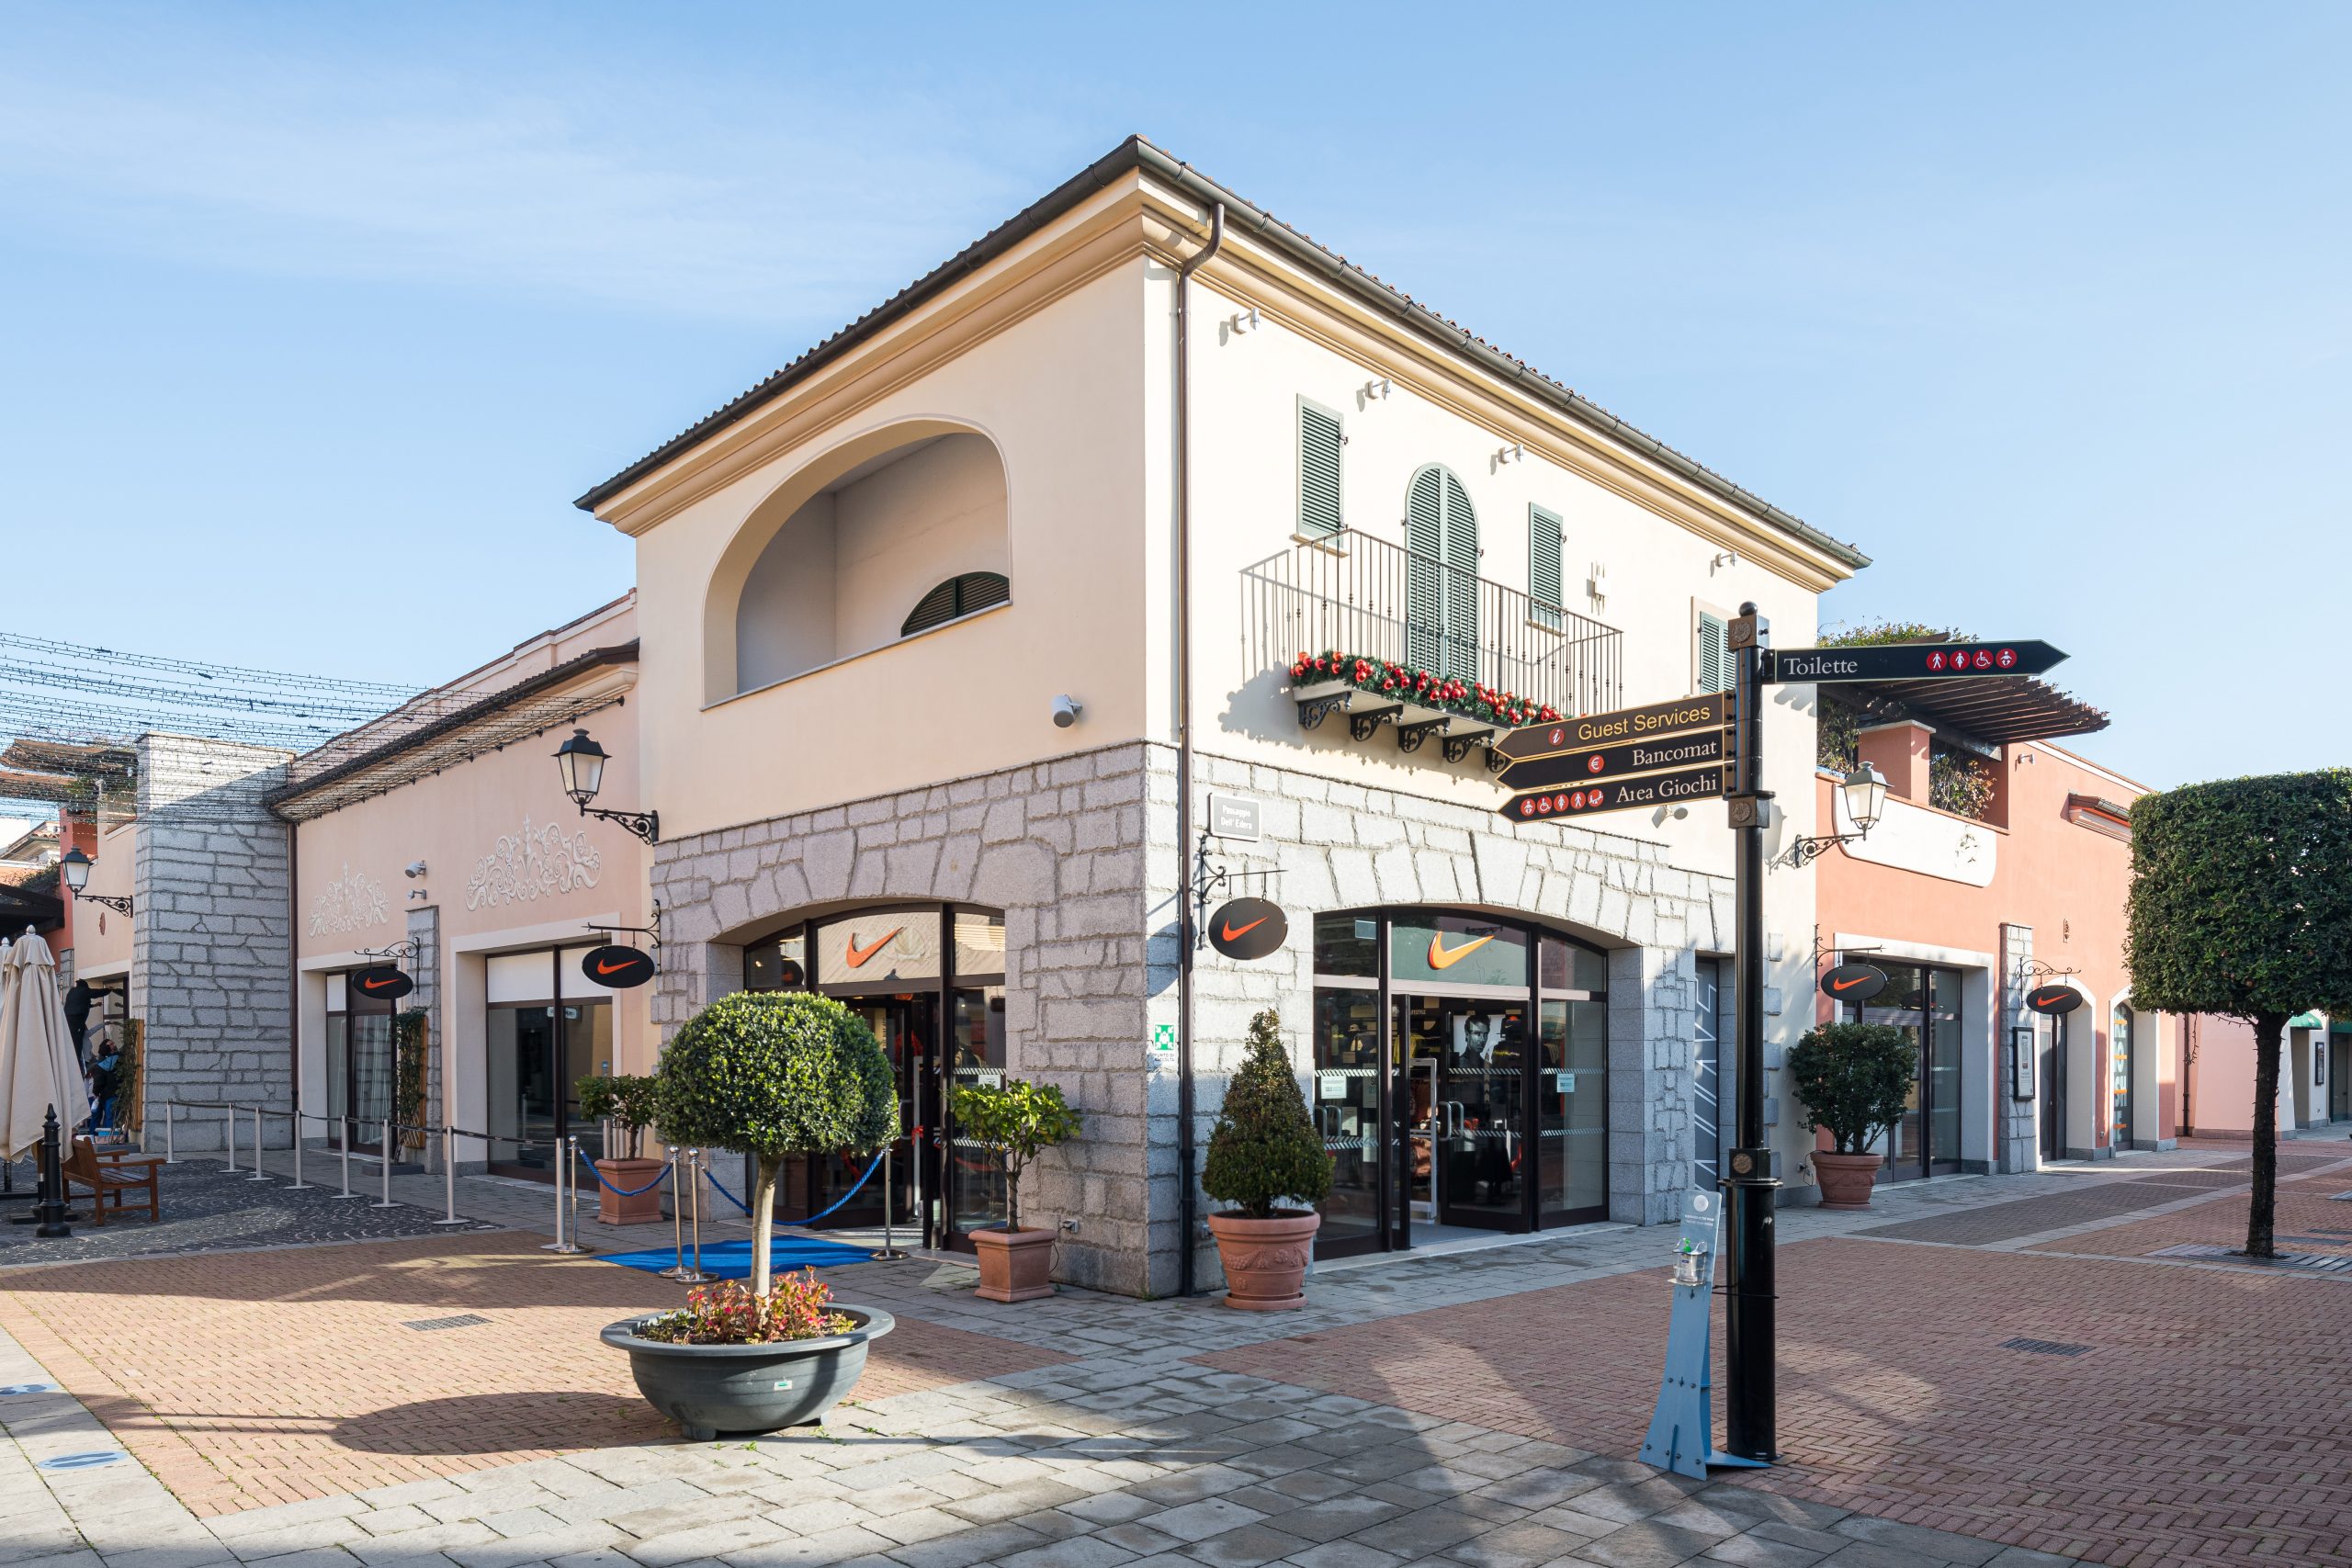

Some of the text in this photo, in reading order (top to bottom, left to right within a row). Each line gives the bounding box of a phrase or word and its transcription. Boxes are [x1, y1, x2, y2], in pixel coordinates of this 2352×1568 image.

[1783, 656, 1858, 675] Toilette
[1578, 706, 1711, 740] Guest Services
[1632, 740, 1717, 766] Bancomat
[1658, 773, 1717, 797] Giochi
[1223, 805, 1251, 818] Passaggio
[1235, 818, 1252, 829] Edera
